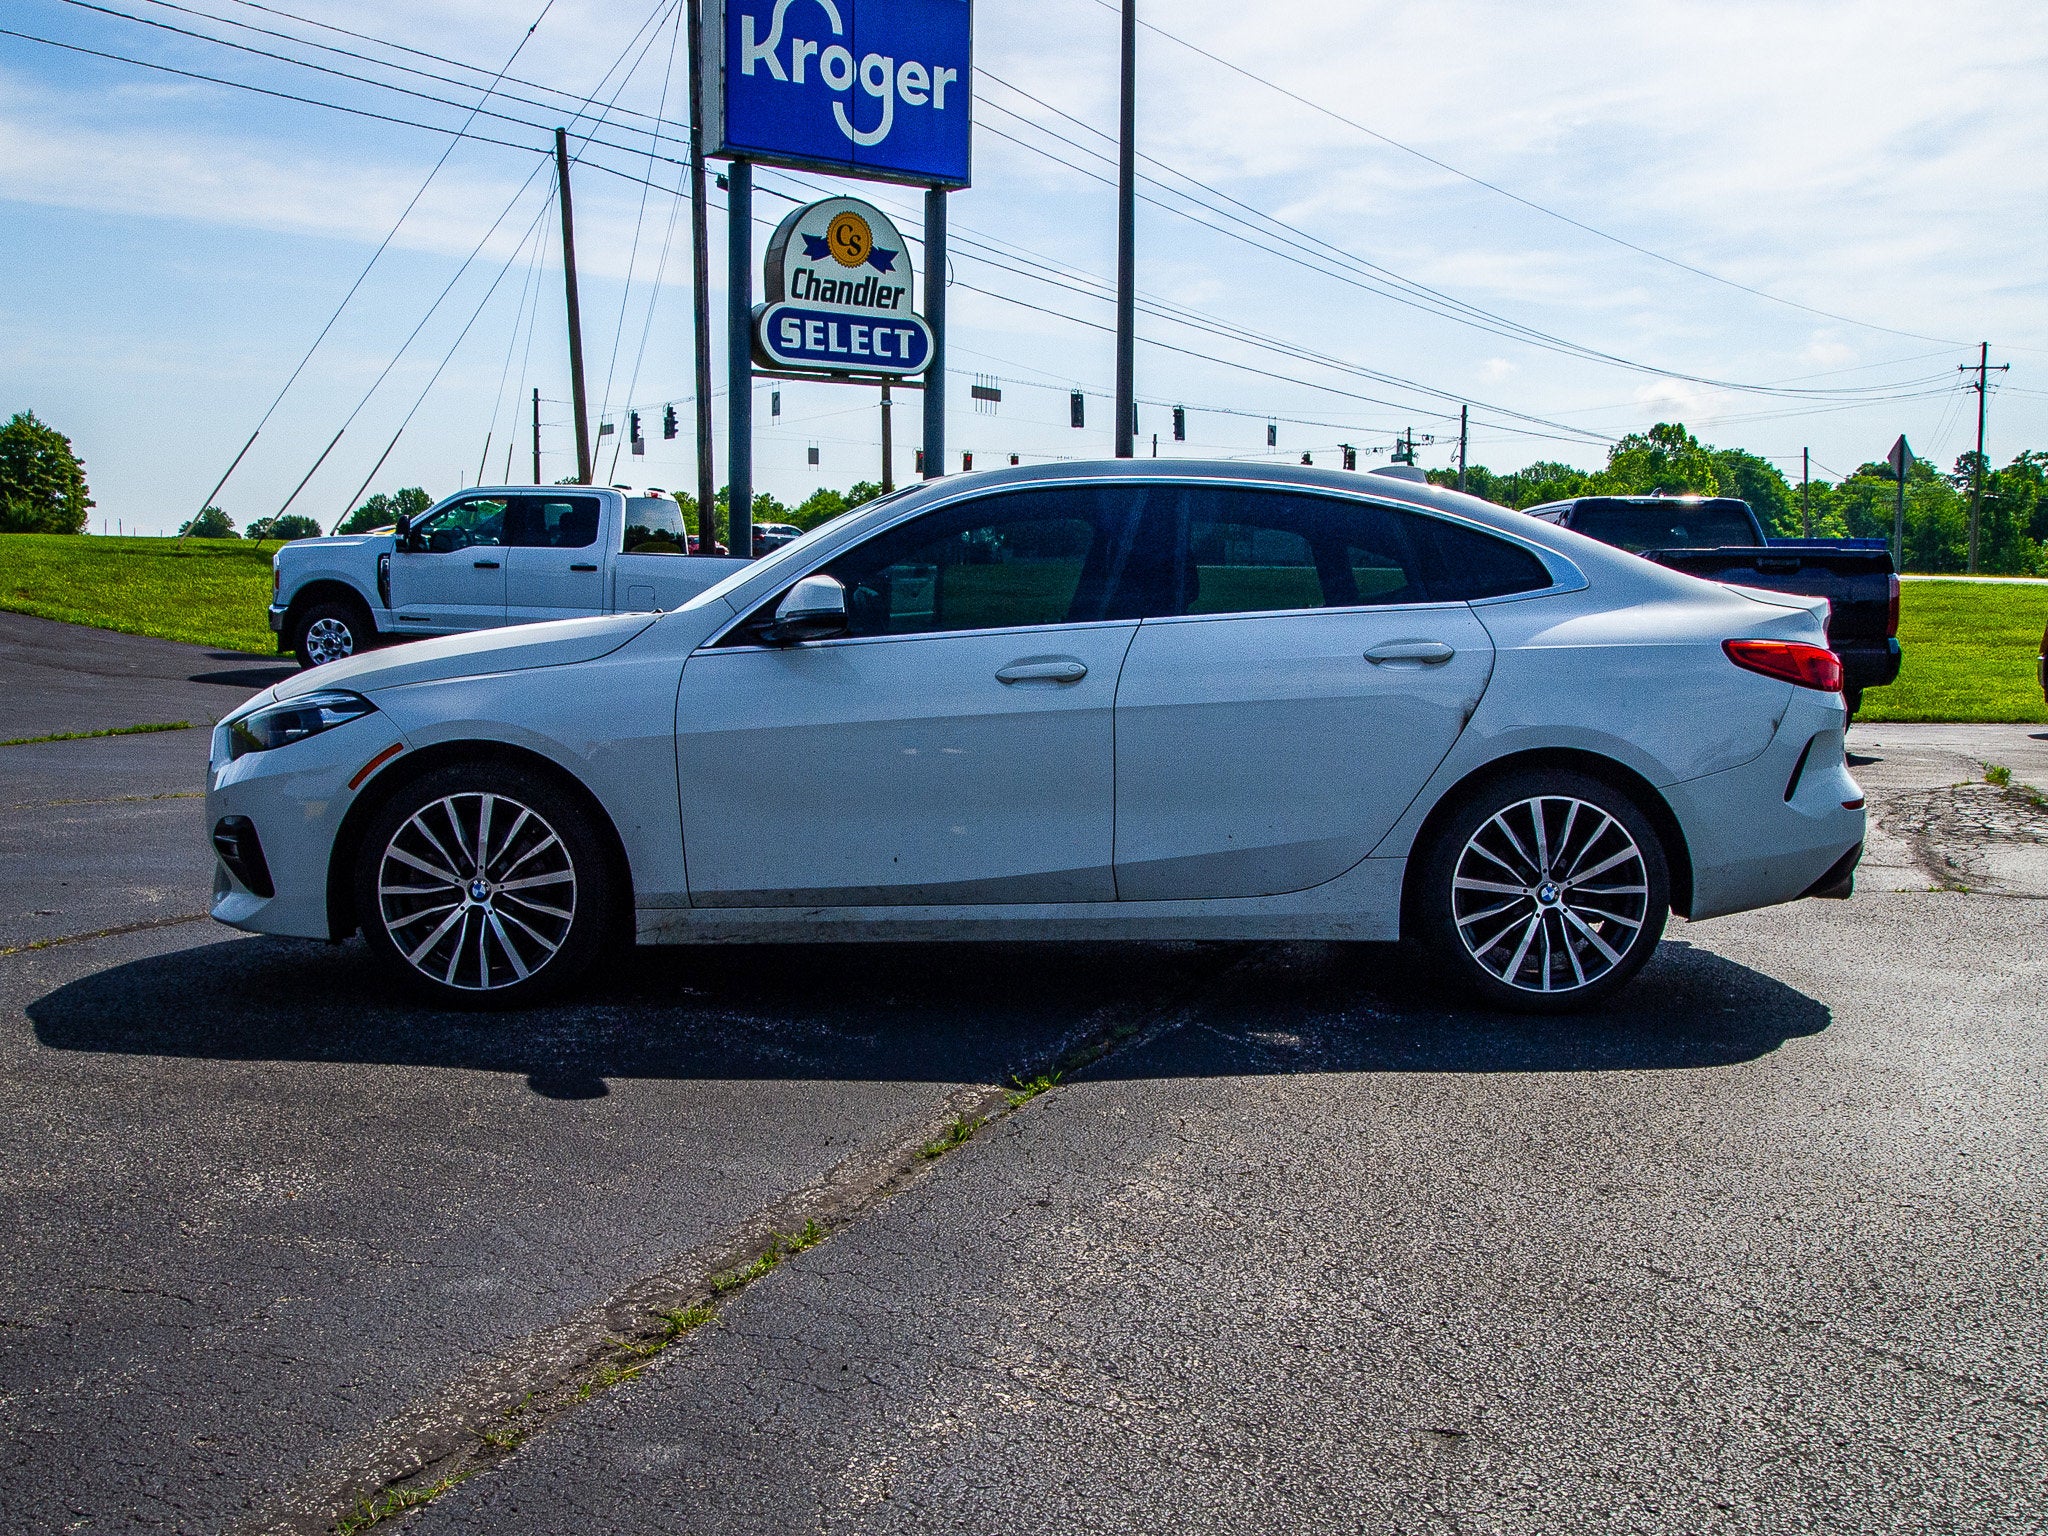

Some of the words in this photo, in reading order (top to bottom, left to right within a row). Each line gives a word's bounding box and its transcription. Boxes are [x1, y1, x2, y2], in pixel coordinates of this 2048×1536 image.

[741, 0, 957, 146] Kroger
[835, 223, 861, 256] CS
[791, 267, 905, 310] Chandler
[780, 317, 915, 359] SELECT
